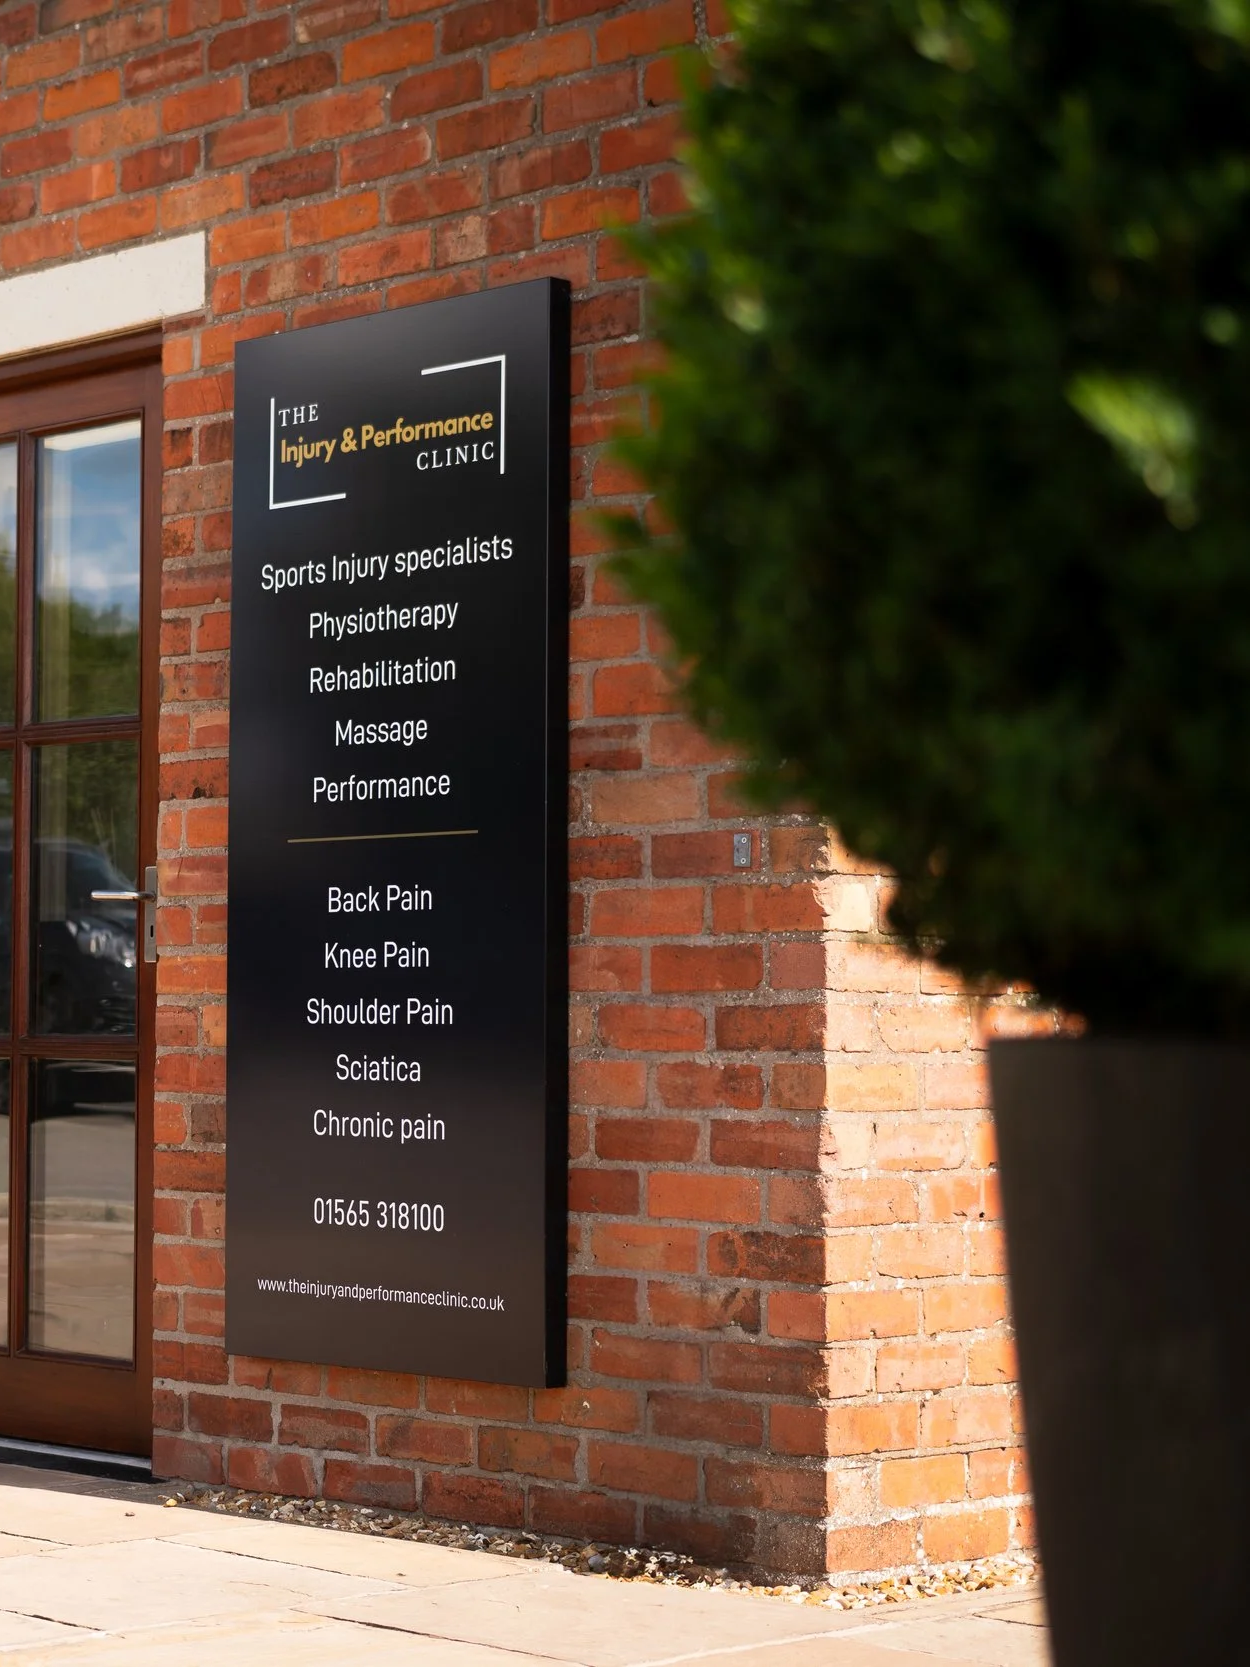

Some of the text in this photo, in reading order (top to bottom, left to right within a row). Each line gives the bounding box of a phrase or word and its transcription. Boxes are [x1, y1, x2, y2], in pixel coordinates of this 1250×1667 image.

[278, 403, 319, 427] THE
[280, 412, 494, 468] Injury & Performance
[416, 441, 494, 471] CLINIC
[261, 535, 513, 594] Sports Injury specialists
[309, 602, 459, 641] Physiotherapy
[310, 656, 456, 694] Rehabilitation
[335, 719, 428, 747] Massage
[313, 774, 451, 803] Performance
[328, 884, 433, 913] Back Pain
[324, 941, 430, 969] Knee Pain
[306, 997, 453, 1025] Shoulder Pain
[336, 1053, 421, 1082] Sciatica
[313, 1108, 446, 1145] Chronic pain
[313, 1197, 445, 1233] 01565 318100
[257, 1277, 505, 1312] www.theinjuryandperformanceclinic.co.uk
